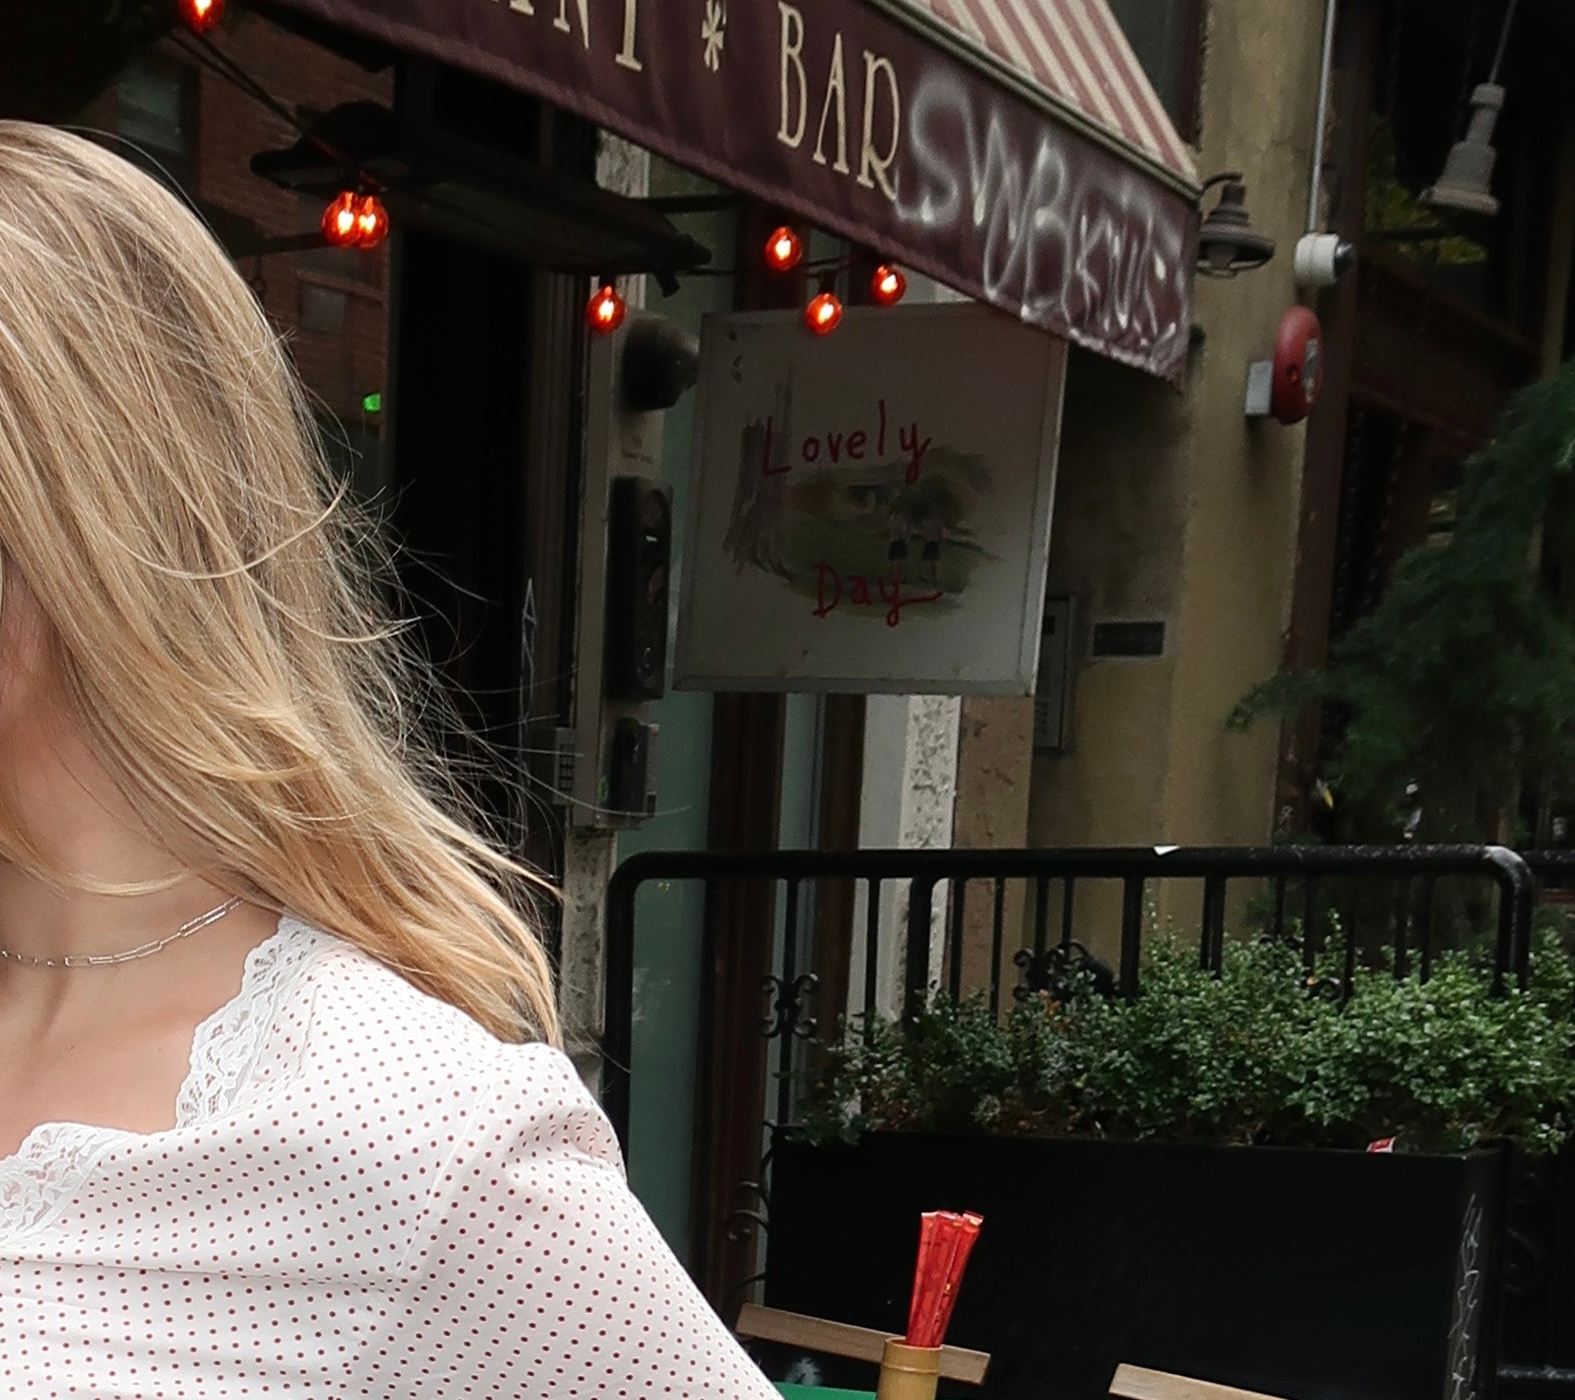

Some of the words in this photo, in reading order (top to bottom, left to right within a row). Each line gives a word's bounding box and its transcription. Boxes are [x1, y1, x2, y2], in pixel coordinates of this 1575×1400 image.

[776, 1, 900, 200] BAR
[763, 398, 931, 483] Lovely
[812, 559, 944, 628] Day
